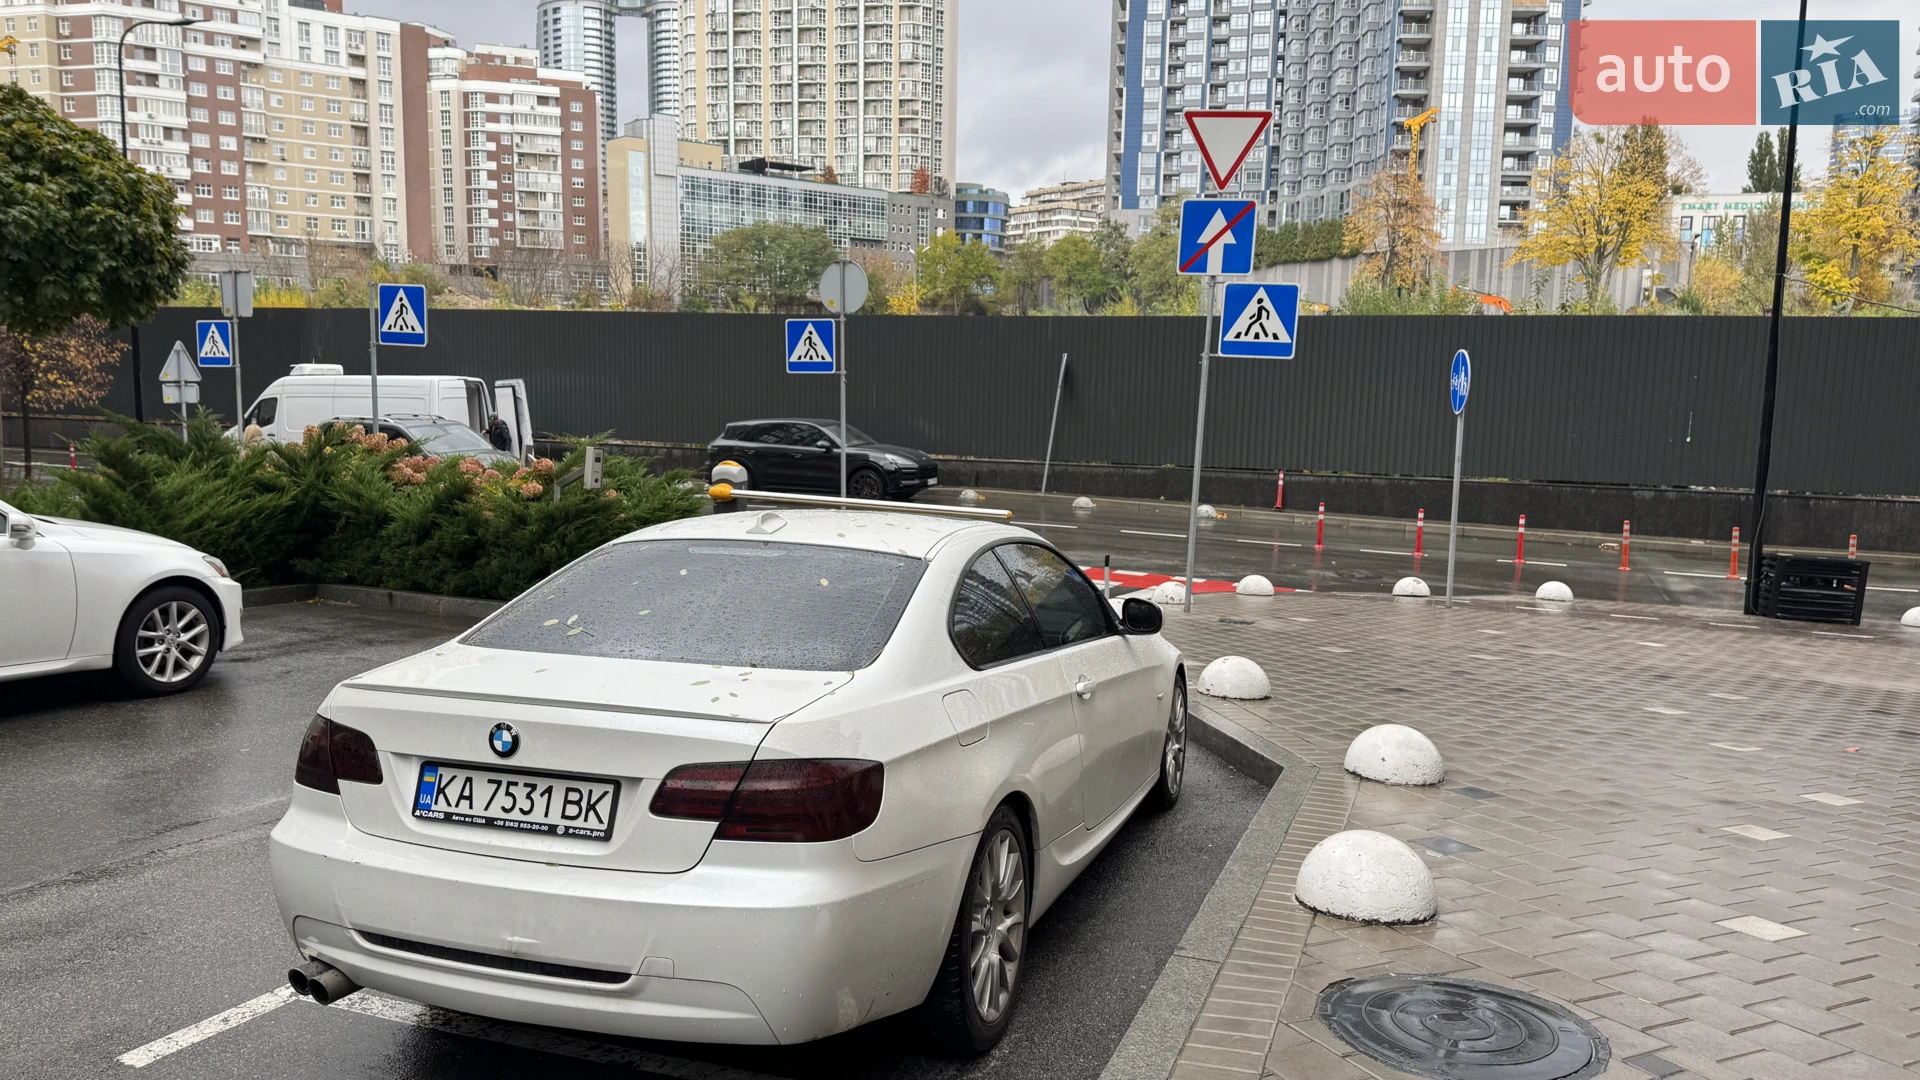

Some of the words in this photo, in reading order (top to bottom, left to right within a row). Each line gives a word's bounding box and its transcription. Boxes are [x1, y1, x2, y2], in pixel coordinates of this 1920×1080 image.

[1681, 202, 1719, 211] SMART
[1723, 202, 1772, 211] MEDIC
[419, 793, 432, 805] UA
[434, 773, 474, 810] KA
[483, 778, 554, 818] 7531
[561, 786, 610, 825] BK
[414, 809, 445, 819] A'CARS
[568, 827, 605, 838] a-cars.pro
